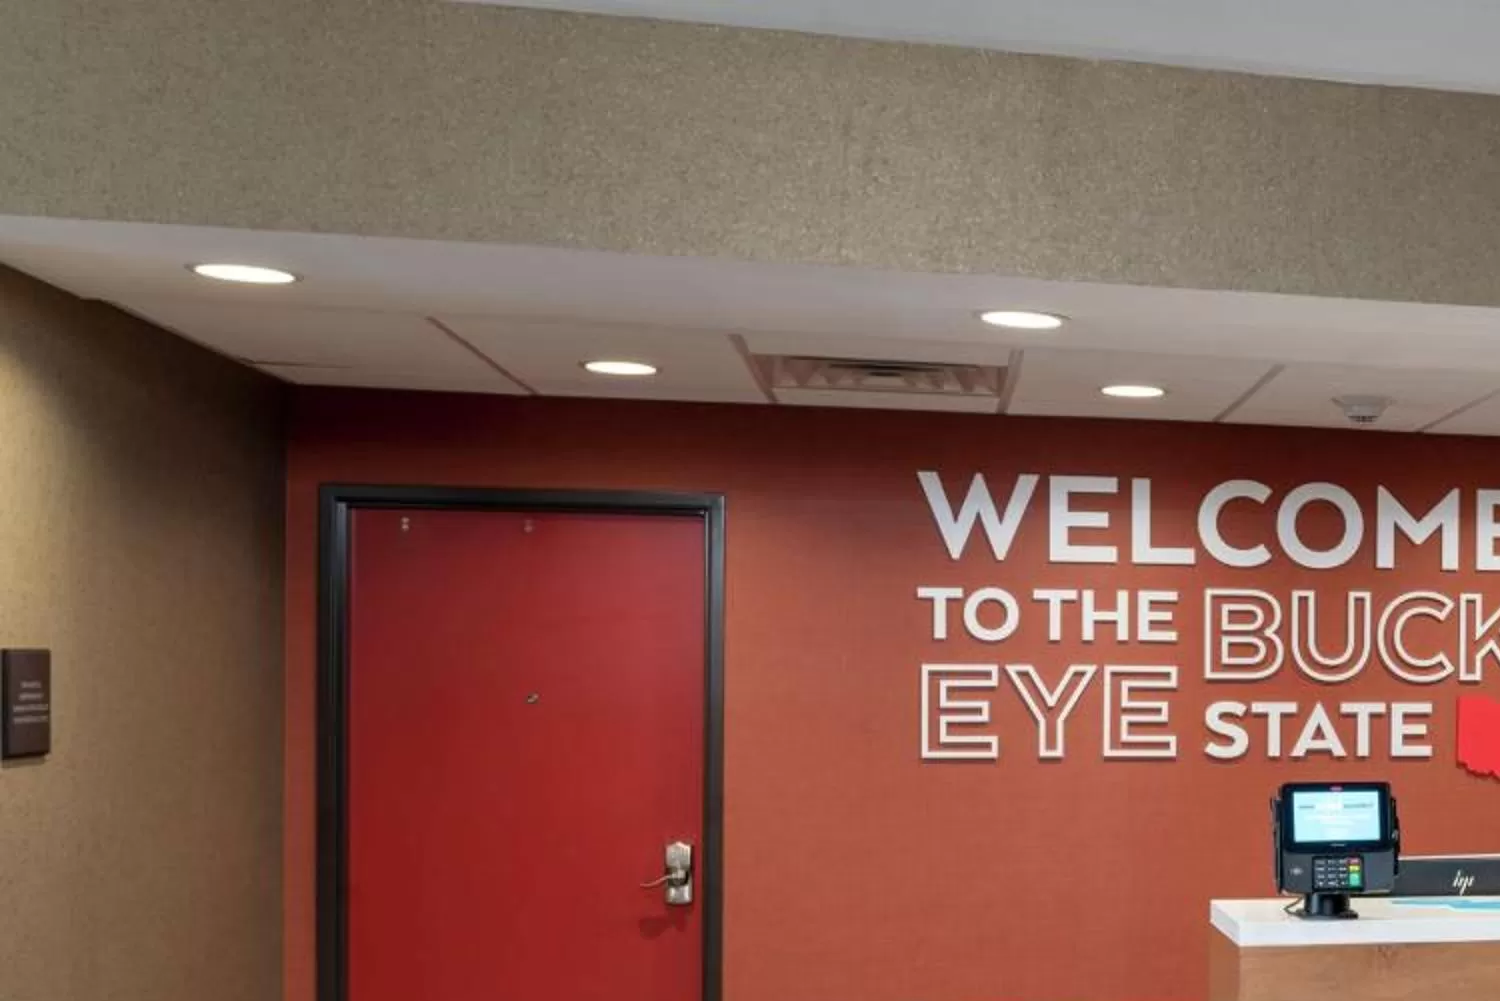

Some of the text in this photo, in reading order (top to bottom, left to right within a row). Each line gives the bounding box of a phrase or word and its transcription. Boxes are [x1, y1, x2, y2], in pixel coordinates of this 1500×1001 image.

[917, 586, 1020, 642] TO
[1032, 587, 1179, 642] THE
[920, 662, 1433, 759] EYE STATE
